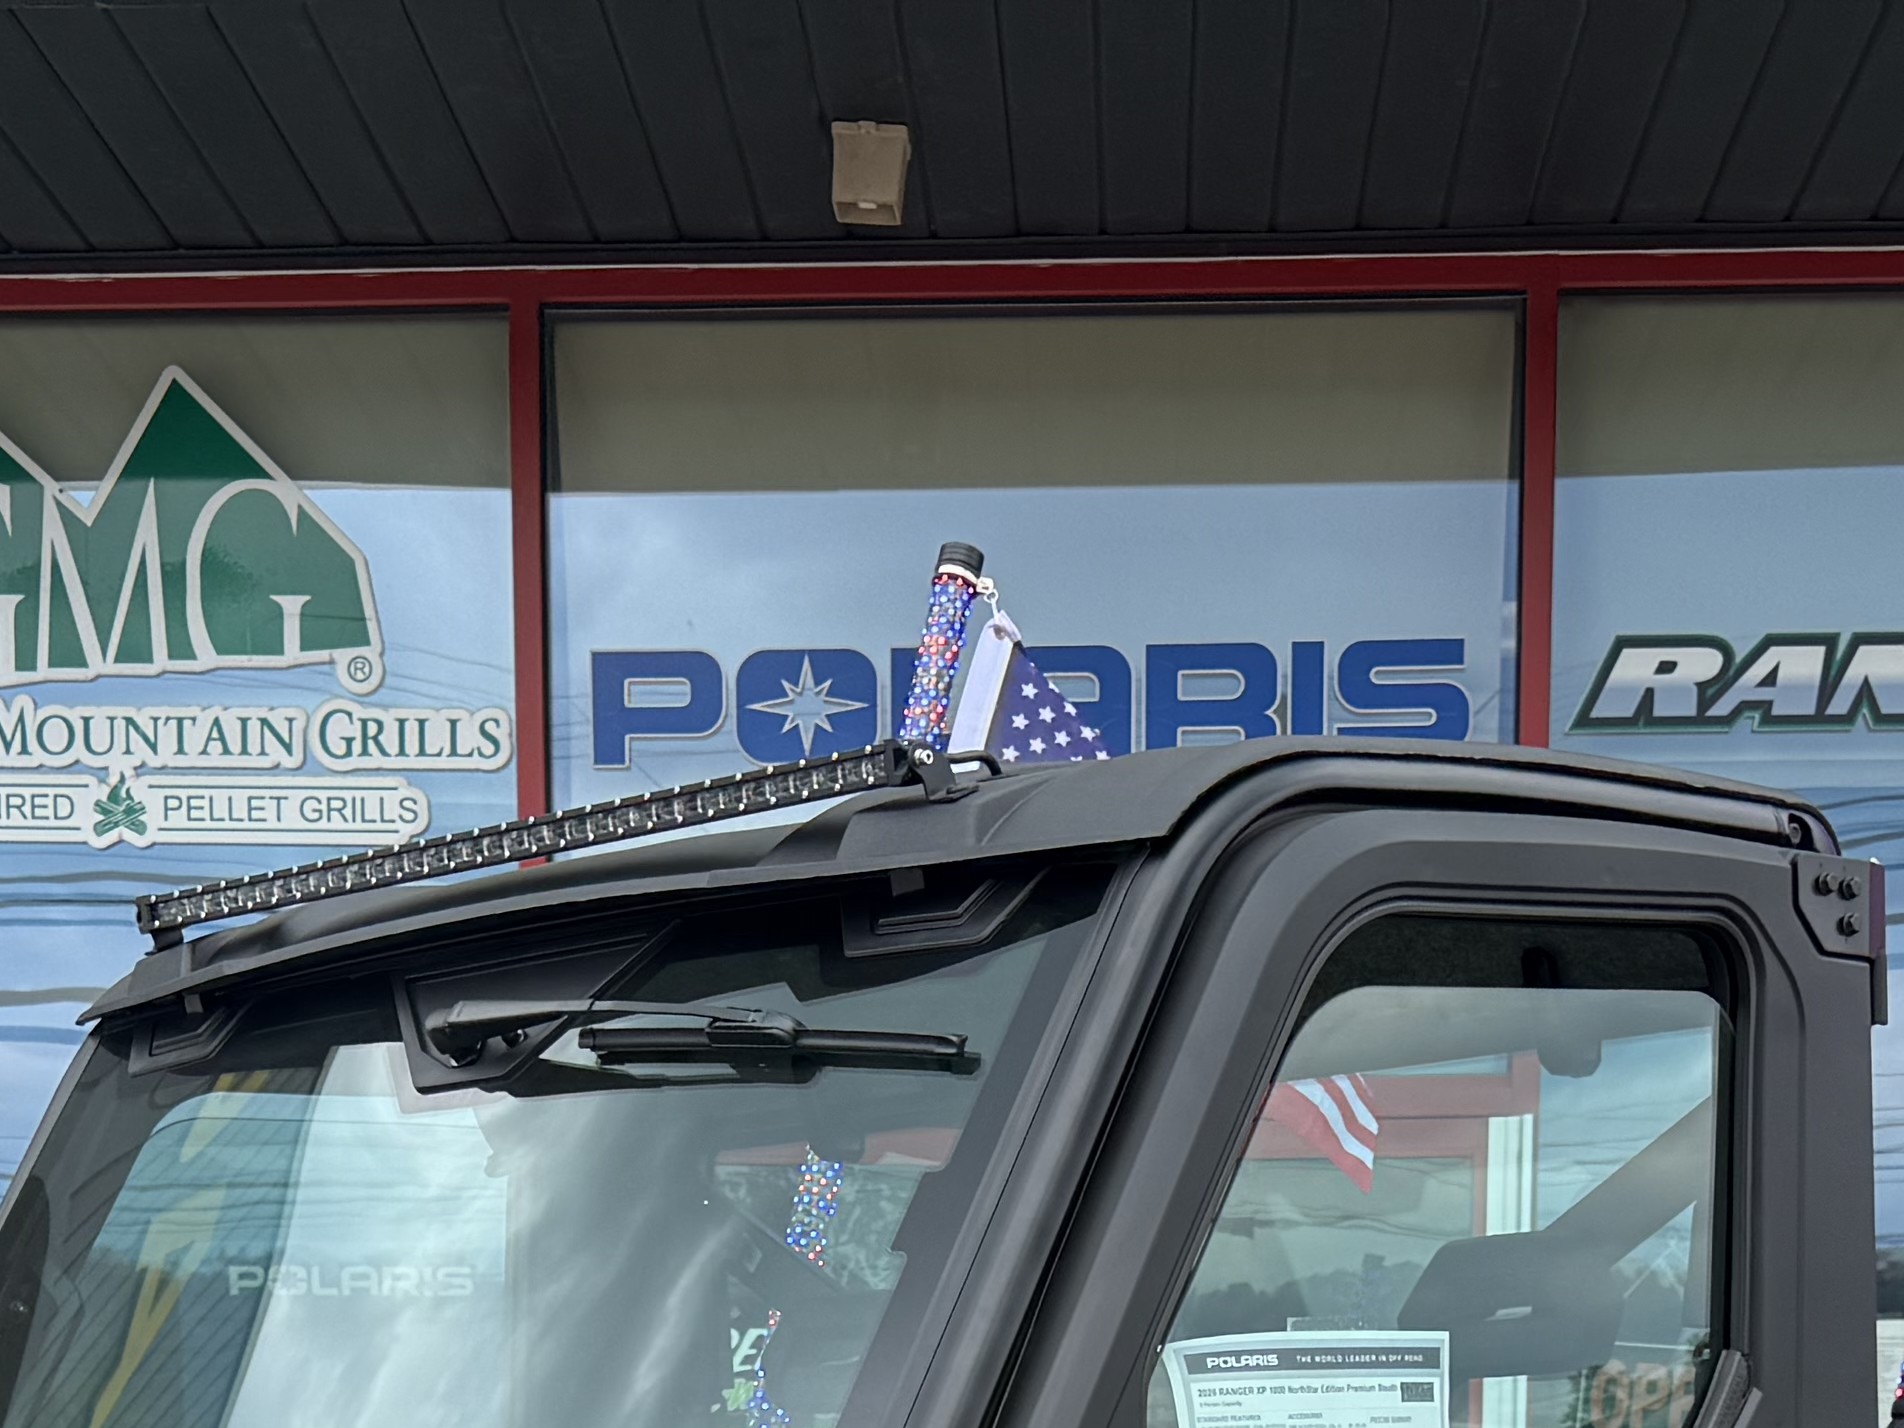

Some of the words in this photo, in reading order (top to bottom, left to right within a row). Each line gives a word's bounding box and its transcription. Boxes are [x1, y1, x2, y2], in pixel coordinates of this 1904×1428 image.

[319, 707, 502, 761] GRILLS
[163, 795, 288, 824] PELLET
[299, 795, 420, 827] GRILLS
[227, 1265, 475, 1298] POLARIS
[1206, 1354, 1278, 1369] POLARIS
[1219, 1386, 1254, 1397] RANGER
